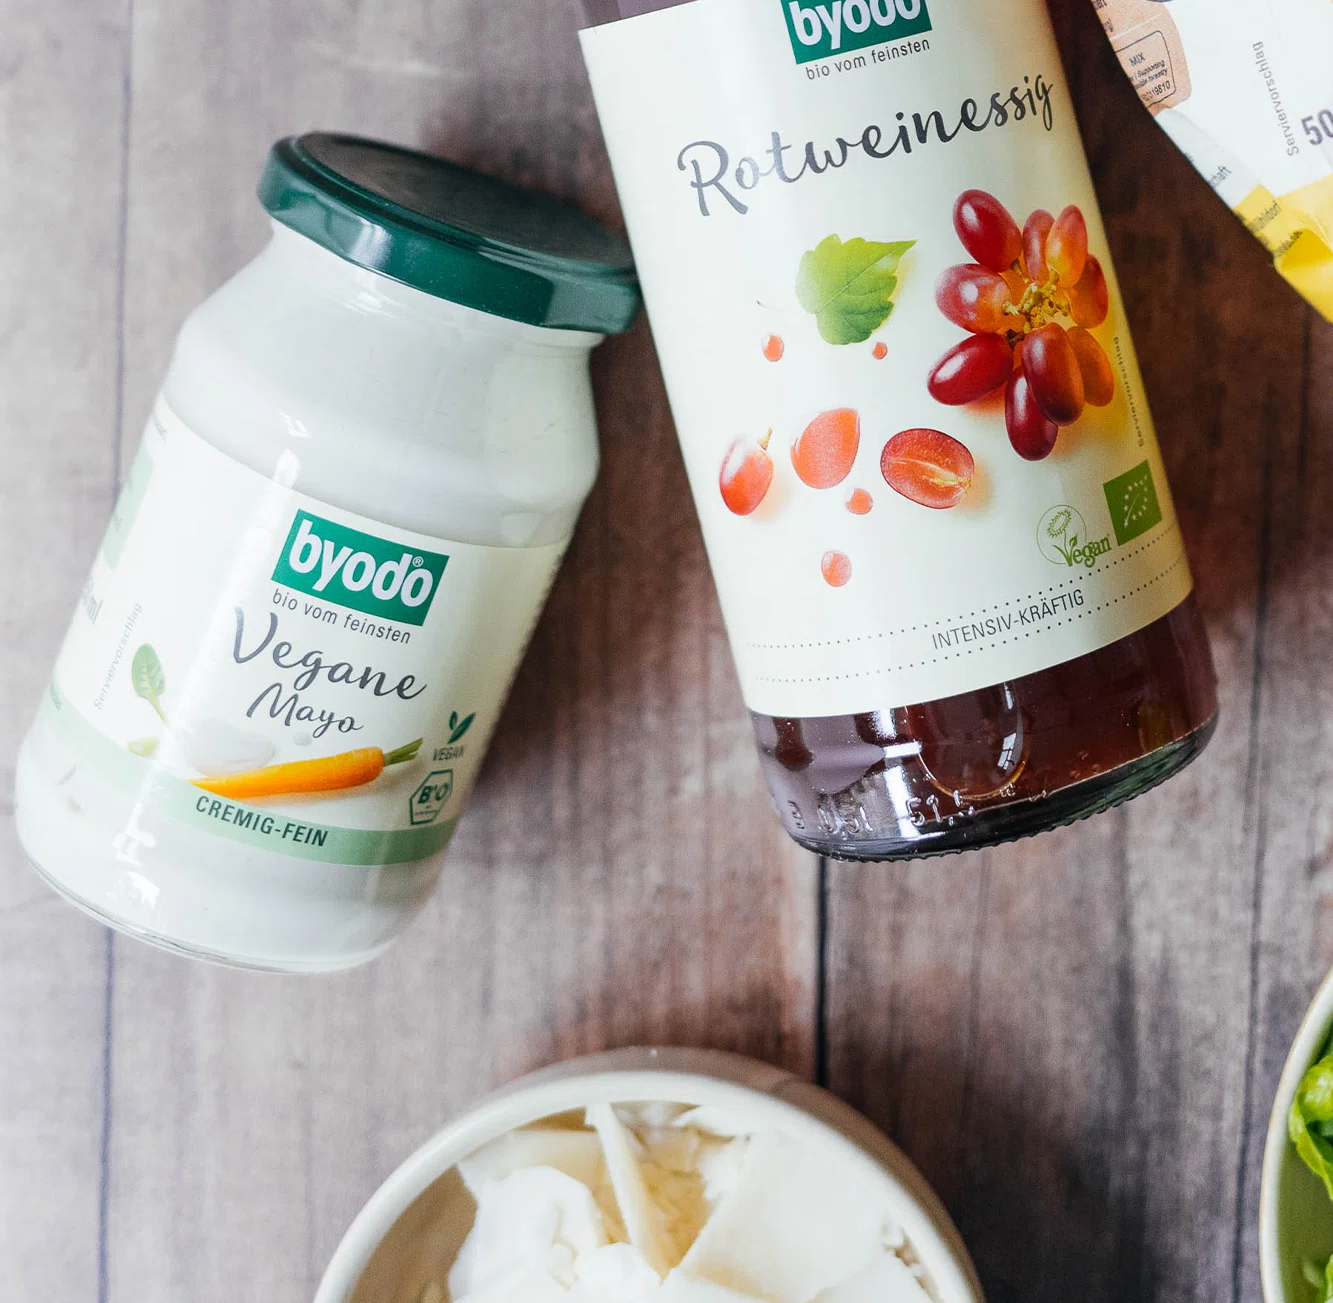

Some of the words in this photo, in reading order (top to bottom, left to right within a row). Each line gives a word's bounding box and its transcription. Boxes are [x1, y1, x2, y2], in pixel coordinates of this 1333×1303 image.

[806, 64, 830, 80] bio
[834, 54, 867, 73] vom
[871, 39, 931, 64] feinsten
[1129, 52, 1145, 67] MIX
[1252, 41, 1300, 157] Serviervorschlag
[677, 74, 1054, 217] Rotweinessig
[1050, 533, 1113, 568] Vegan
[272, 588, 299, 611] bio
[304, 602, 338, 625] vom
[343, 613, 411, 645] feinsten
[931, 589, 1085, 650] INTENSIV-KRÄFTIG
[93, 601, 144, 711] Serviervorschlag
[233, 606, 428, 700] Vegane
[246, 682, 364, 739] Mayo
[433, 745, 465, 762] VEGAN
[195, 795, 329, 847] CREMIG-FEIN
